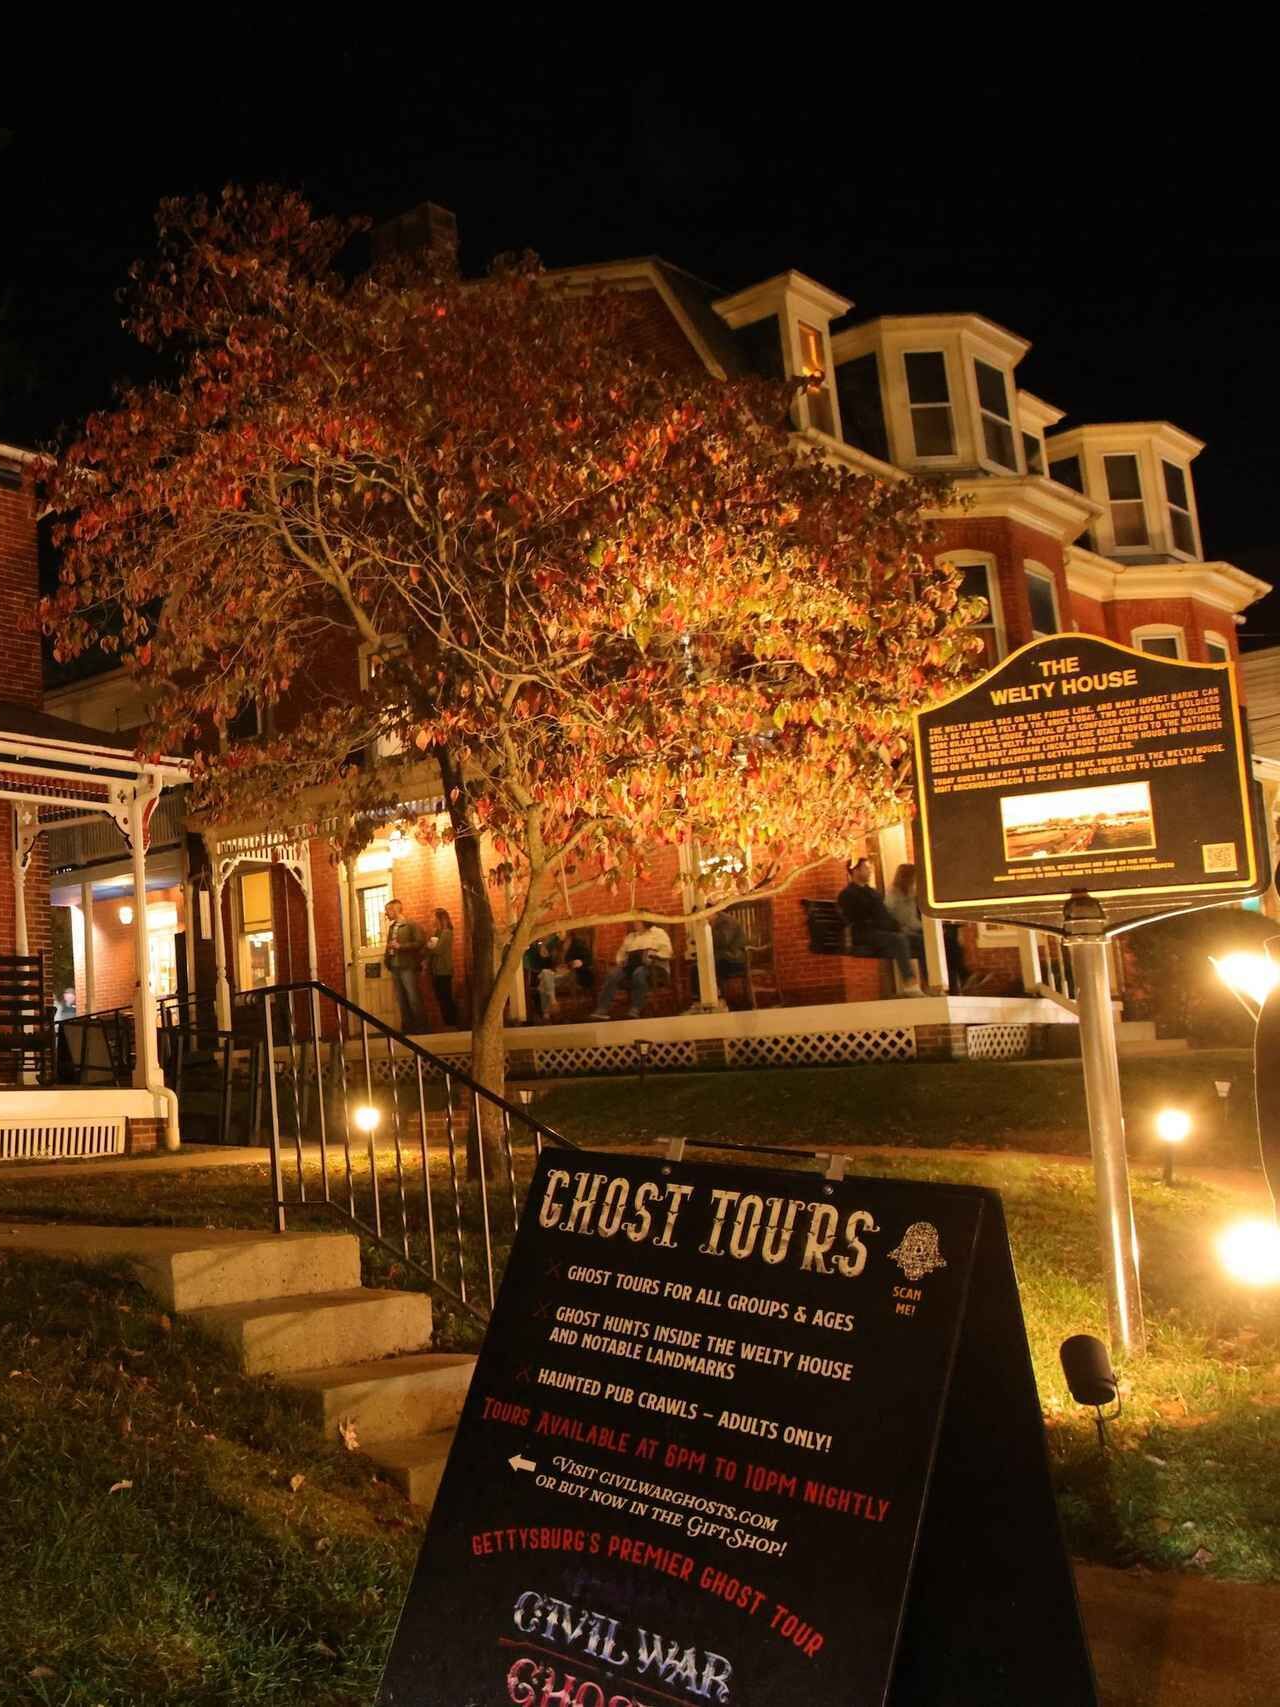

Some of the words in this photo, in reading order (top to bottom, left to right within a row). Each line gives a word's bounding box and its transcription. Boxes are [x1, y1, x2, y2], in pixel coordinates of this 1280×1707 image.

[990, 681, 1056, 706] WELTY
[1061, 668, 1139, 695] HOUSE
[1039, 656, 1081, 677] THE
[928, 733, 949, 742] STILL
[961, 729, 980, 738] SEEN
[982, 726, 996, 735] AND
[998, 724, 1016, 733] FELT
[1018, 722, 1028, 730] ON
[1030, 720, 1045, 728] THE
[1099, 710, 1116, 719] TWO
[1119, 701, 1177, 716] CONFEDERATE
[1178, 695, 1219, 708] SOLDIERS
[929, 726, 942, 734] THE
[944, 723, 967, 732] WELTY
[969, 719, 993, 728] HOUSE
[996, 717, 1011, 725] WAS
[1026, 712, 1041, 720] THE
[1096, 702, 1112, 710] AND
[1115, 699, 1135, 708] MANY
[1138, 694, 1167, 705] IMPACT
[1170, 690, 1198, 700] MARKS
[1201, 687, 1218, 696] CAN
[929, 741, 948, 750] WERE
[949, 738, 974, 747] KILLED
[984, 734, 999, 742] THE
[1033, 726, 1055, 736] TOTAL
[1056, 725, 1065, 733] OF
[1078, 715, 1137, 729] CONFEDERATES
[1138, 713, 1153, 721] AND
[1155, 709, 1180, 719] UNION
[1182, 704, 1220, 715] SOLDIERS
[930, 749, 948, 757] WERE
[986, 742, 1000, 750] THE
[1002, 739, 1024, 748] WELTY
[1026, 733, 1064, 745] PROPERTY
[1065, 729, 1095, 739] BEFORE
[1122, 722, 1148, 732] MOVED
[1150, 720, 1161, 728] TO
[1163, 718, 1179, 726] THE
[1181, 712, 1221, 724] NATIONAL
[949, 763, 959, 771] ON
[1046, 745, 1095, 758] GETTYSBURG
[968, 749, 1007, 760] PRESIDENT
[1042, 740, 1073, 750] LINCOLN
[1076, 737, 1097, 746] RODE
[1099, 734, 1118, 743] PAST
[1120, 732, 1138, 740] THIS
[1140, 728, 1167, 738] HOUSE
[1179, 721, 1222, 733] NOVEMBER
[933, 785, 951, 793] VISIT
[1036, 772, 1056, 781] SCAN
[1058, 770, 1073, 778] THE
[1087, 766, 1108, 775] CODE
[1110, 762, 1136, 772] BELOW
[1152, 757, 1177, 767] LEARN
[986, 771, 1001, 779] MAY
[1002, 768, 1020, 777] STAY
[1022, 766, 1036, 774] THE
[1037, 763, 1061, 772] NIGHT
[1075, 759, 1095, 767] TAKE
[1096, 756, 1122, 765] TOURS
[1125, 753, 1145, 762] WITH
[1148, 751, 1164, 759] THE
[1166, 747, 1194, 757] WELTY
[539, 1169, 694, 1248] GHOST
[698, 1189, 880, 1277] TOURS
[568, 1266, 612, 1286] GHOST
[616, 1273, 660, 1295] TOURS
[664, 1282, 692, 1301] FOR
[696, 1288, 721, 1307] ALL
[727, 1294, 789, 1319] GROUPS
[794, 1306, 806, 1323] &
[812, 1310, 854, 1331] AGES
[892, 1286, 922, 1301] SCAN
[896, 1303, 916, 1317] ME!
[549, 1327, 578, 1345] AND
[581, 1333, 643, 1360] NOTABLE
[646, 1347, 736, 1380] LANDMARKS
[556, 1306, 600, 1327] GHOST
[603, 1315, 650, 1338] HUNTS
[654, 1325, 702, 1349] INSIDE
[707, 1336, 736, 1356] THE
[740, 1342, 794, 1368] WELTY
[798, 1354, 854, 1381] HOUSE
[538, 1368, 601, 1396] HAUNTED
[604, 1384, 634, 1404] PUB
[638, 1392, 698, 1420] CRAWLS
[718, 1411, 779, 1439] ADULTS
[783, 1426, 832, 1453] ONLY!
[482, 1397, 531, 1426] TOURS
[536, 1412, 631, 1453] AVAILABLE
[635, 1438, 660, 1461] AT
[664, 1444, 706, 1474] 6PM
[713, 1456, 737, 1482] TO
[744, 1464, 798, 1499] 10PM
[804, 1480, 890, 1522] NIGHTLY
[535, 1474, 556, 1490] OR
[558, 1481, 589, 1499] BUY
[590, 1490, 628, 1511] NOW
[629, 1501, 648, 1517] IN
[651, 1507, 684, 1527] THE
[552, 1456, 598, 1480] VISIT
[599, 1471, 778, 1532] CIVILWARGHOSTS.COM
[472, 1528, 600, 1555] GETTYSBURG'S
[608, 1536, 694, 1582] PREMIER
[700, 1566, 766, 1616] GHOST
[770, 1602, 824, 1658] TOUR
[514, 1591, 628, 1665] CIVIL
[637, 1628, 732, 1704] WAR
